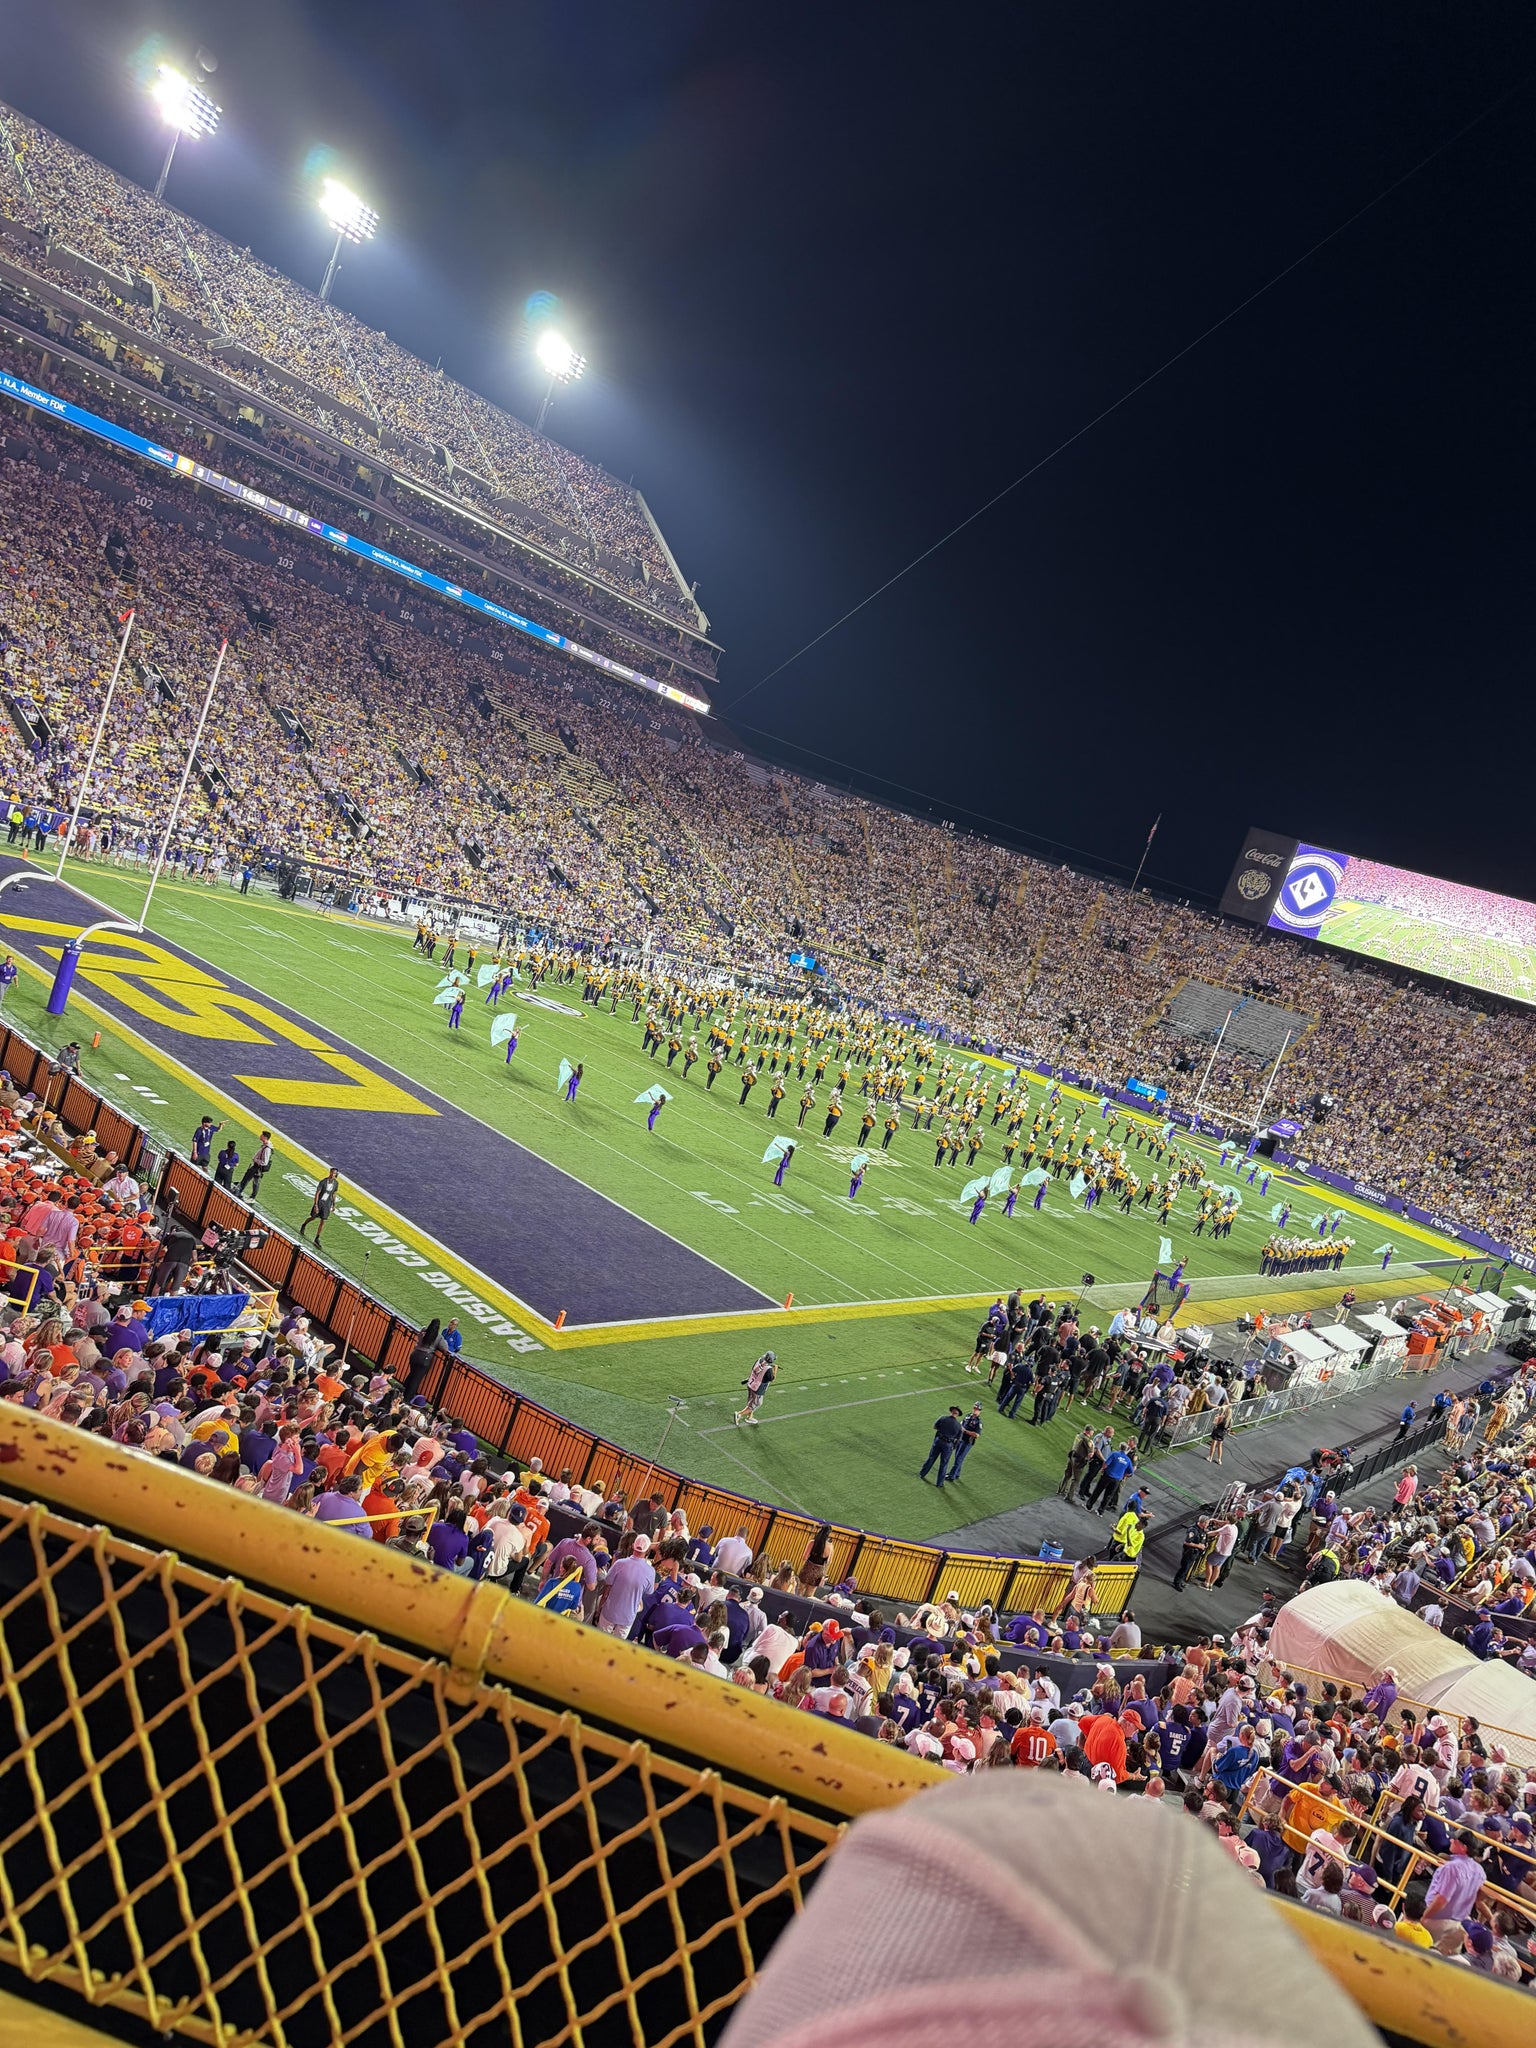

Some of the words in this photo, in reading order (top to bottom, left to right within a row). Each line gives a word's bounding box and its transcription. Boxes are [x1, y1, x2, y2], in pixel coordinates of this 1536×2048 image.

[20, 385, 50, 404] Member
[50, 400, 67, 413] FDIC
[136, 495, 153, 510] 102
[278, 556, 294, 569] 103
[400, 610, 414, 622] 104
[491, 650, 504, 661] 105
[599, 698, 610, 708] 222
[650, 720, 661, 730] 223
[0, 914, 442, 1117] LSU
[1320, 1096, 1334, 1106] 25
[690, 1191, 740, 1214] 5
[1354, 1184, 1387, 1202] COUSHATTA
[751, 1192, 815, 1214] 10
[821, 1195, 880, 1216] 15
[880, 1197, 938, 1216] 20
[333, 1206, 430, 1267] CANE'S
[1509, 1250, 1535, 1269] YETI
[417, 1271, 545, 1354] RAISING
[926, 1695, 937, 1713] 7
[897, 1705, 910, 1730] 7
[1168, 1732, 1188, 1742] DANIELS
[1028, 1736, 1048, 1762] 10
[1170, 1740, 1182, 1756] 5
[1414, 1776, 1429, 1800] 9
[1312, 1810, 1325, 1822] LSU
[1308, 1852, 1325, 1877] 7
